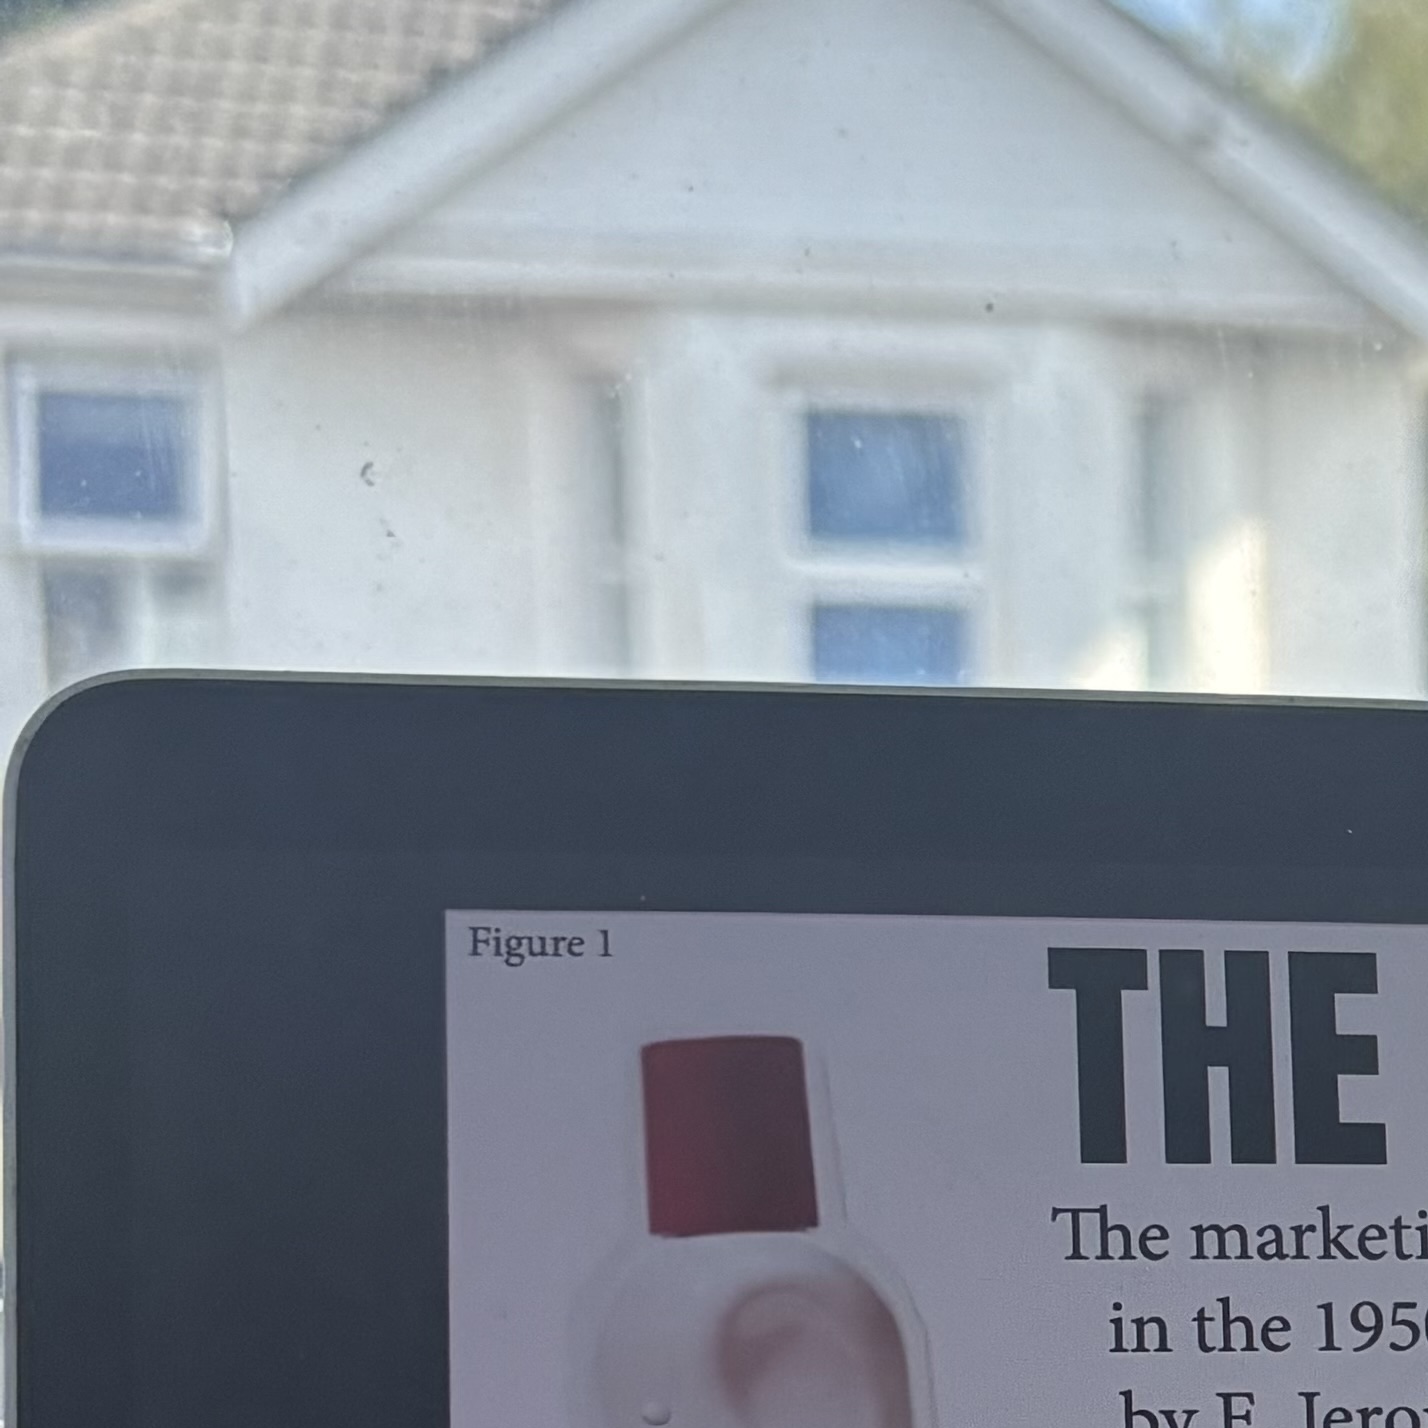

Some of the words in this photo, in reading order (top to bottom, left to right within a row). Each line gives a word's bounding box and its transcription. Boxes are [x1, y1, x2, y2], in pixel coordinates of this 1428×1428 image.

[469, 927, 584, 967] Figure
[600, 930, 611, 957] 1
[1048, 947, 1387, 1164] THE
[1052, 1204, 1169, 1261] The
